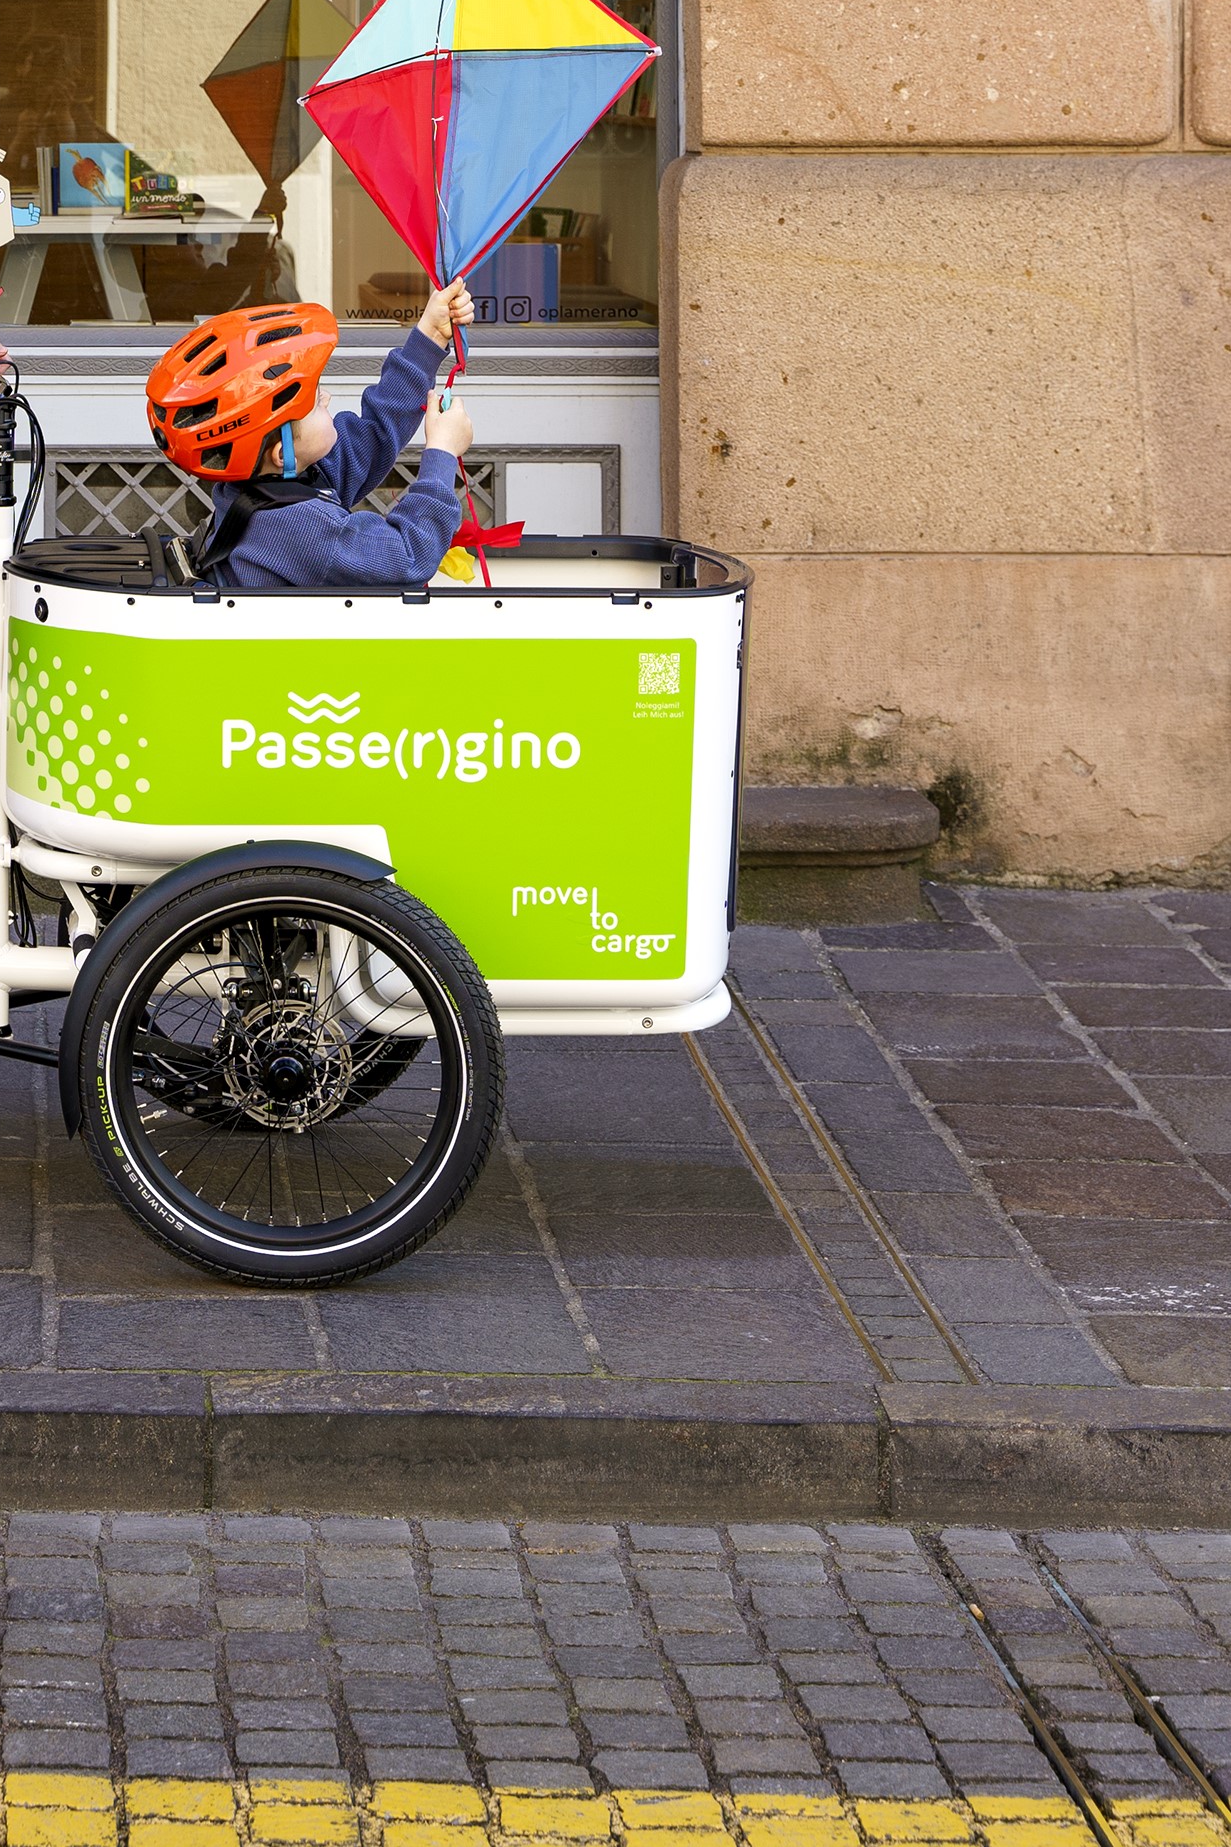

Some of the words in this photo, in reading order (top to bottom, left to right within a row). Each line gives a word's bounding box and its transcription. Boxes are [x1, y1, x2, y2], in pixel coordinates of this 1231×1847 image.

[345, 304, 425, 323] www.opla
[538, 304, 639, 323] oplamerano
[196, 414, 250, 442] CUBE
[633, 711, 648, 719] Leih
[650, 711, 668, 719] Mich
[669, 711, 685, 719] aus!
[222, 718, 581, 783] Passe(r)gino
[512, 886, 588, 917] move
[590, 887, 618, 930] to
[591, 934, 676, 959] cargo
[97, 1075, 116, 1141] PICK-UP
[122, 1162, 185, 1232] SCHWALBE
